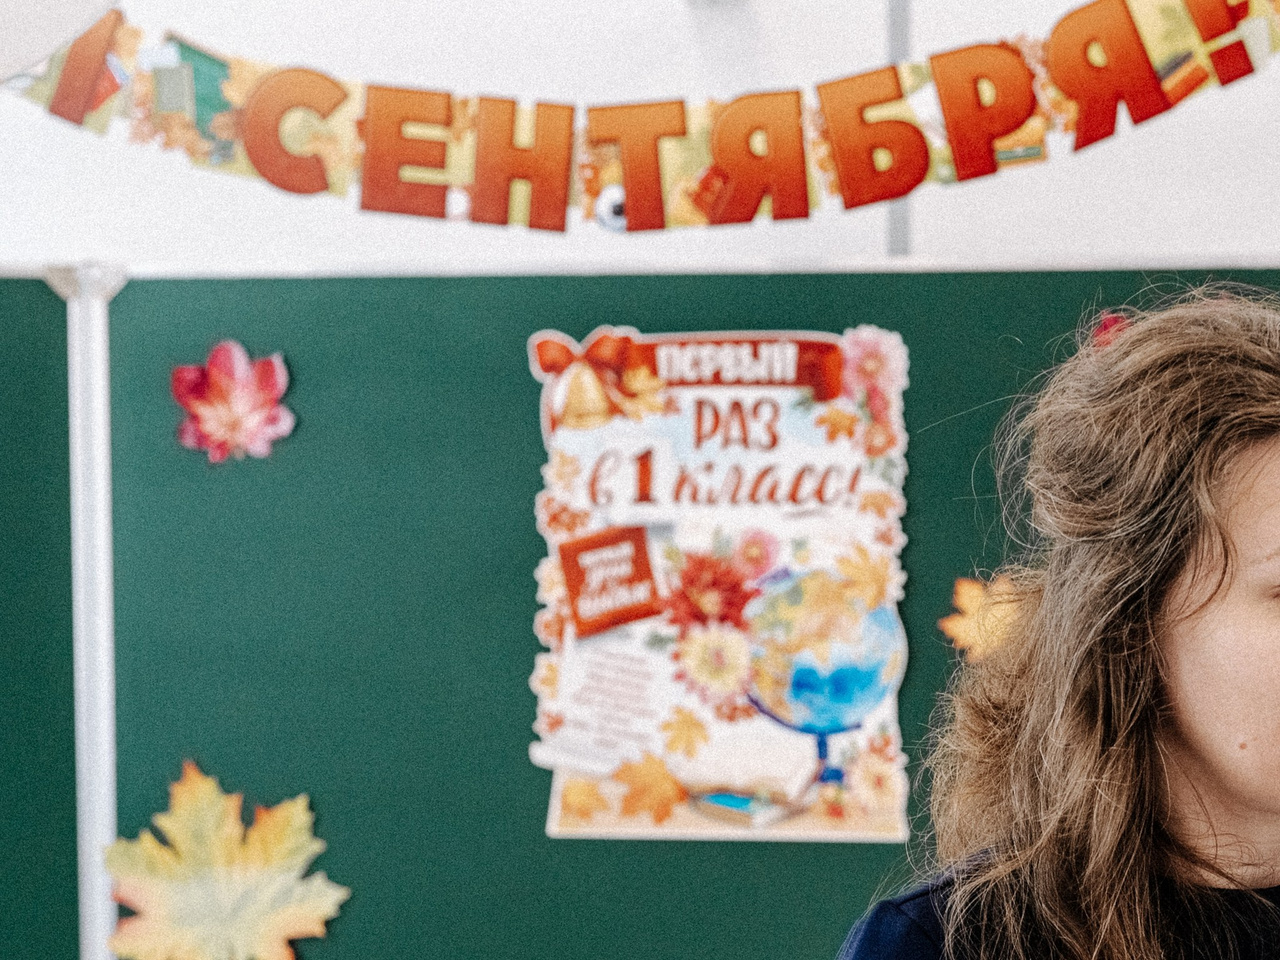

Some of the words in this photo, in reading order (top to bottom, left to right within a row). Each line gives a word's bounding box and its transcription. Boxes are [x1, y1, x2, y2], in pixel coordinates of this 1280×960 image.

[243, 0, 1254, 232] СЕНТЯБРЯ!
[694, 398, 780, 451] РАЗ
[633, 450, 657, 505] 1
[674, 462, 864, 512] класс!
